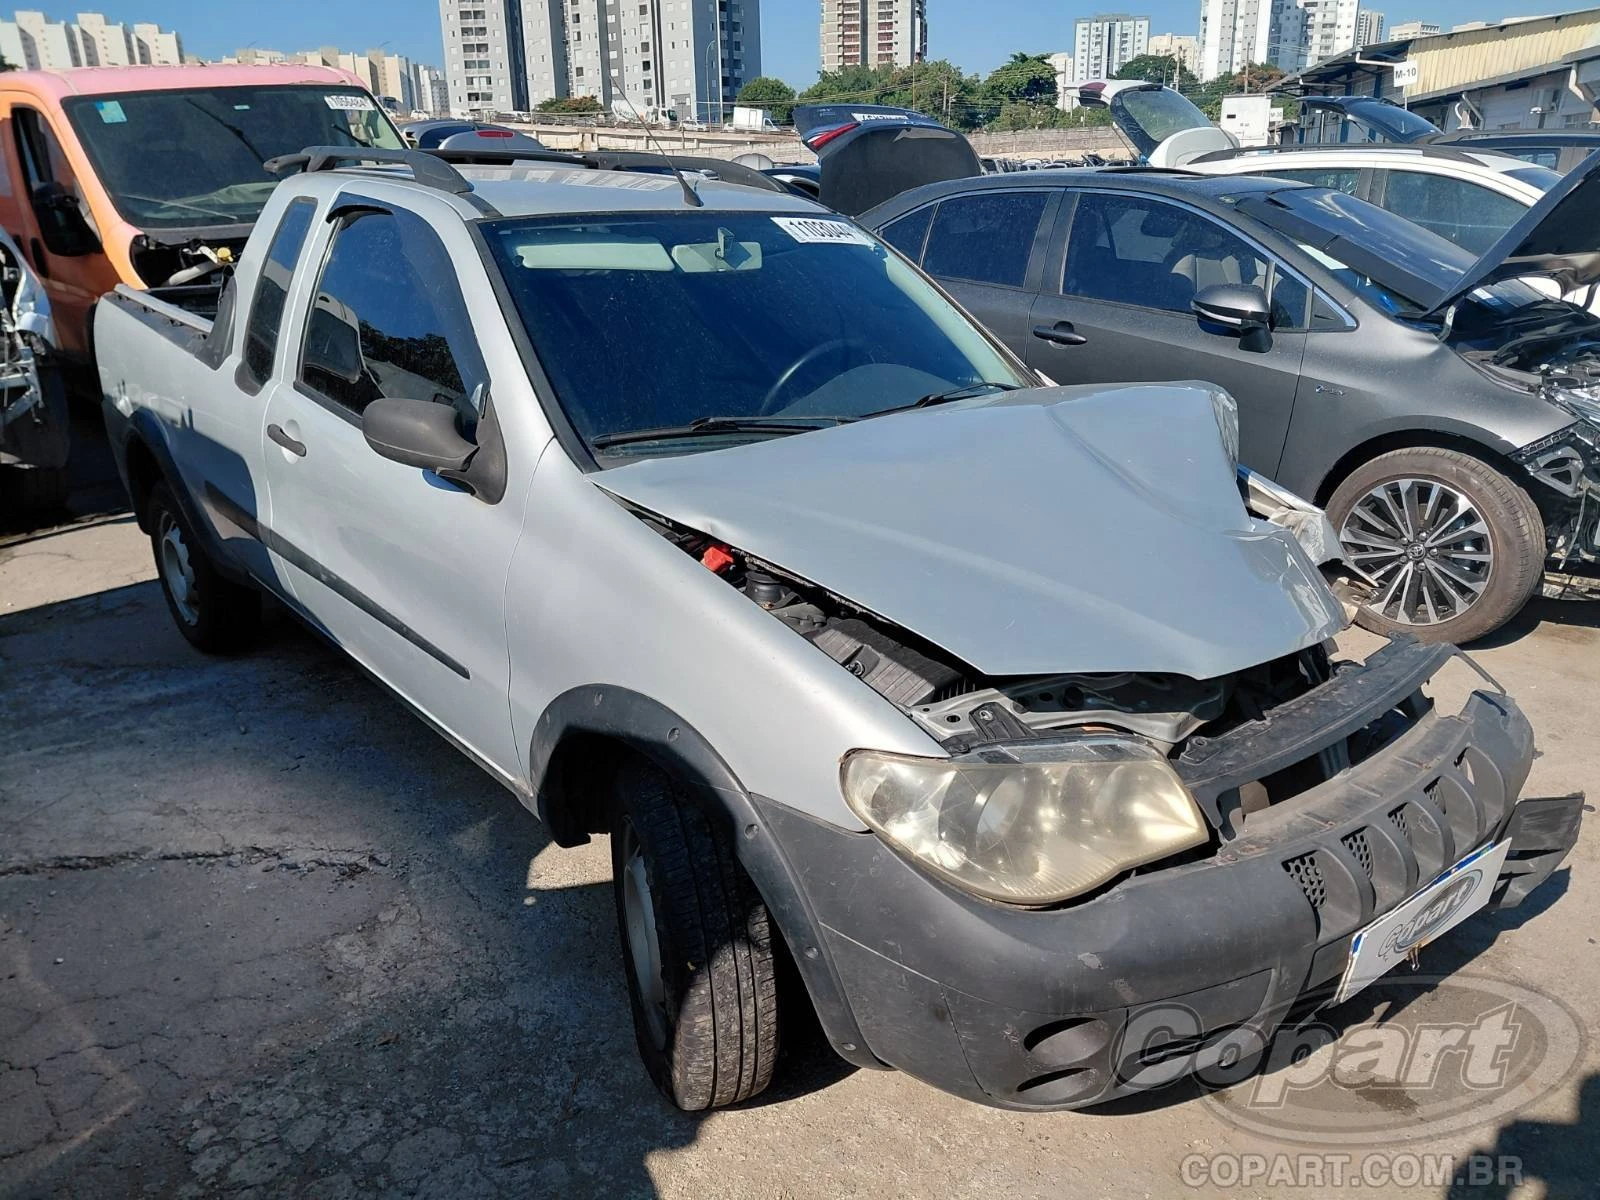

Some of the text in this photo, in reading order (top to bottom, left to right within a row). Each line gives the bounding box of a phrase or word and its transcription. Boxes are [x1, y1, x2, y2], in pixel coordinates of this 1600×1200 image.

[1395, 67, 1417, 79] M-10
[789, 220, 856, 239] 1103044
[1377, 876, 1473, 957] Copart
